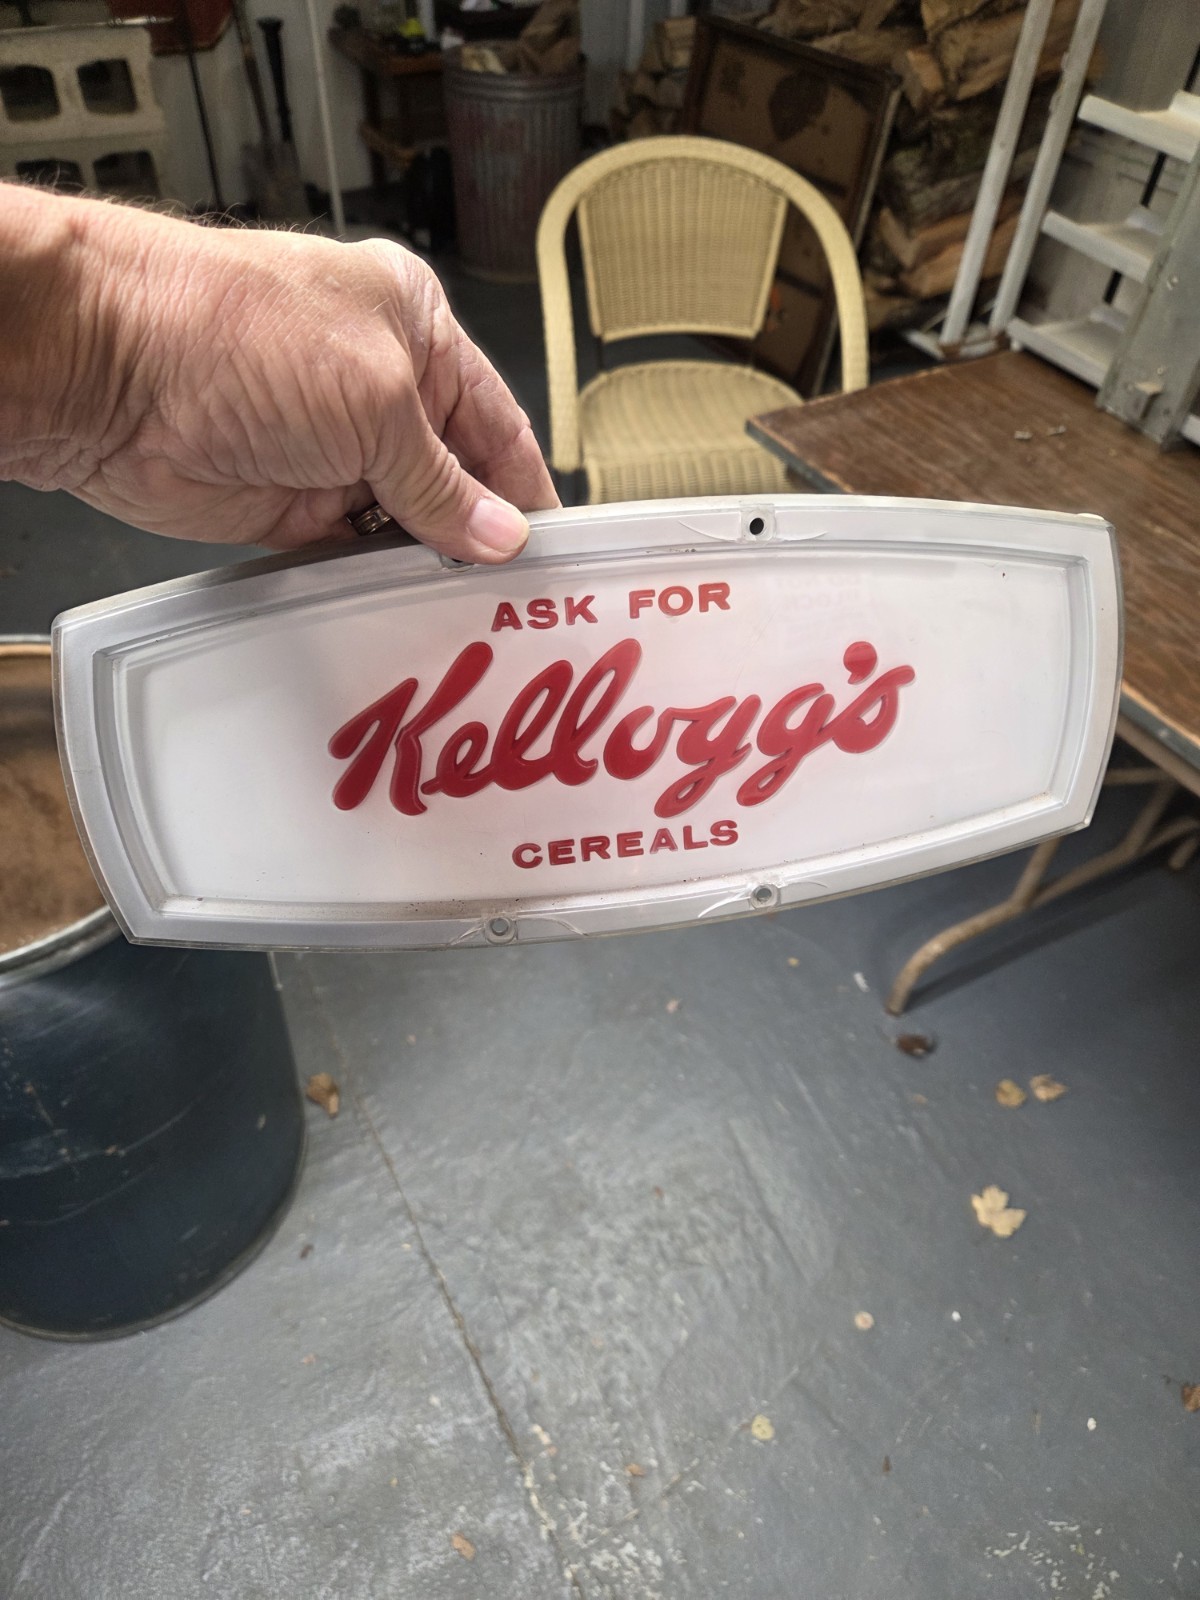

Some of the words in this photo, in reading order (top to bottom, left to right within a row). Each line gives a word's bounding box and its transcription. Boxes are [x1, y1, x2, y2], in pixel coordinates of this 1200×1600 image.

[491, 594, 598, 632] ASK
[629, 581, 731, 619] FOR
[328, 637, 916, 818] Kellogg's
[511, 819, 739, 869] CEREALS
